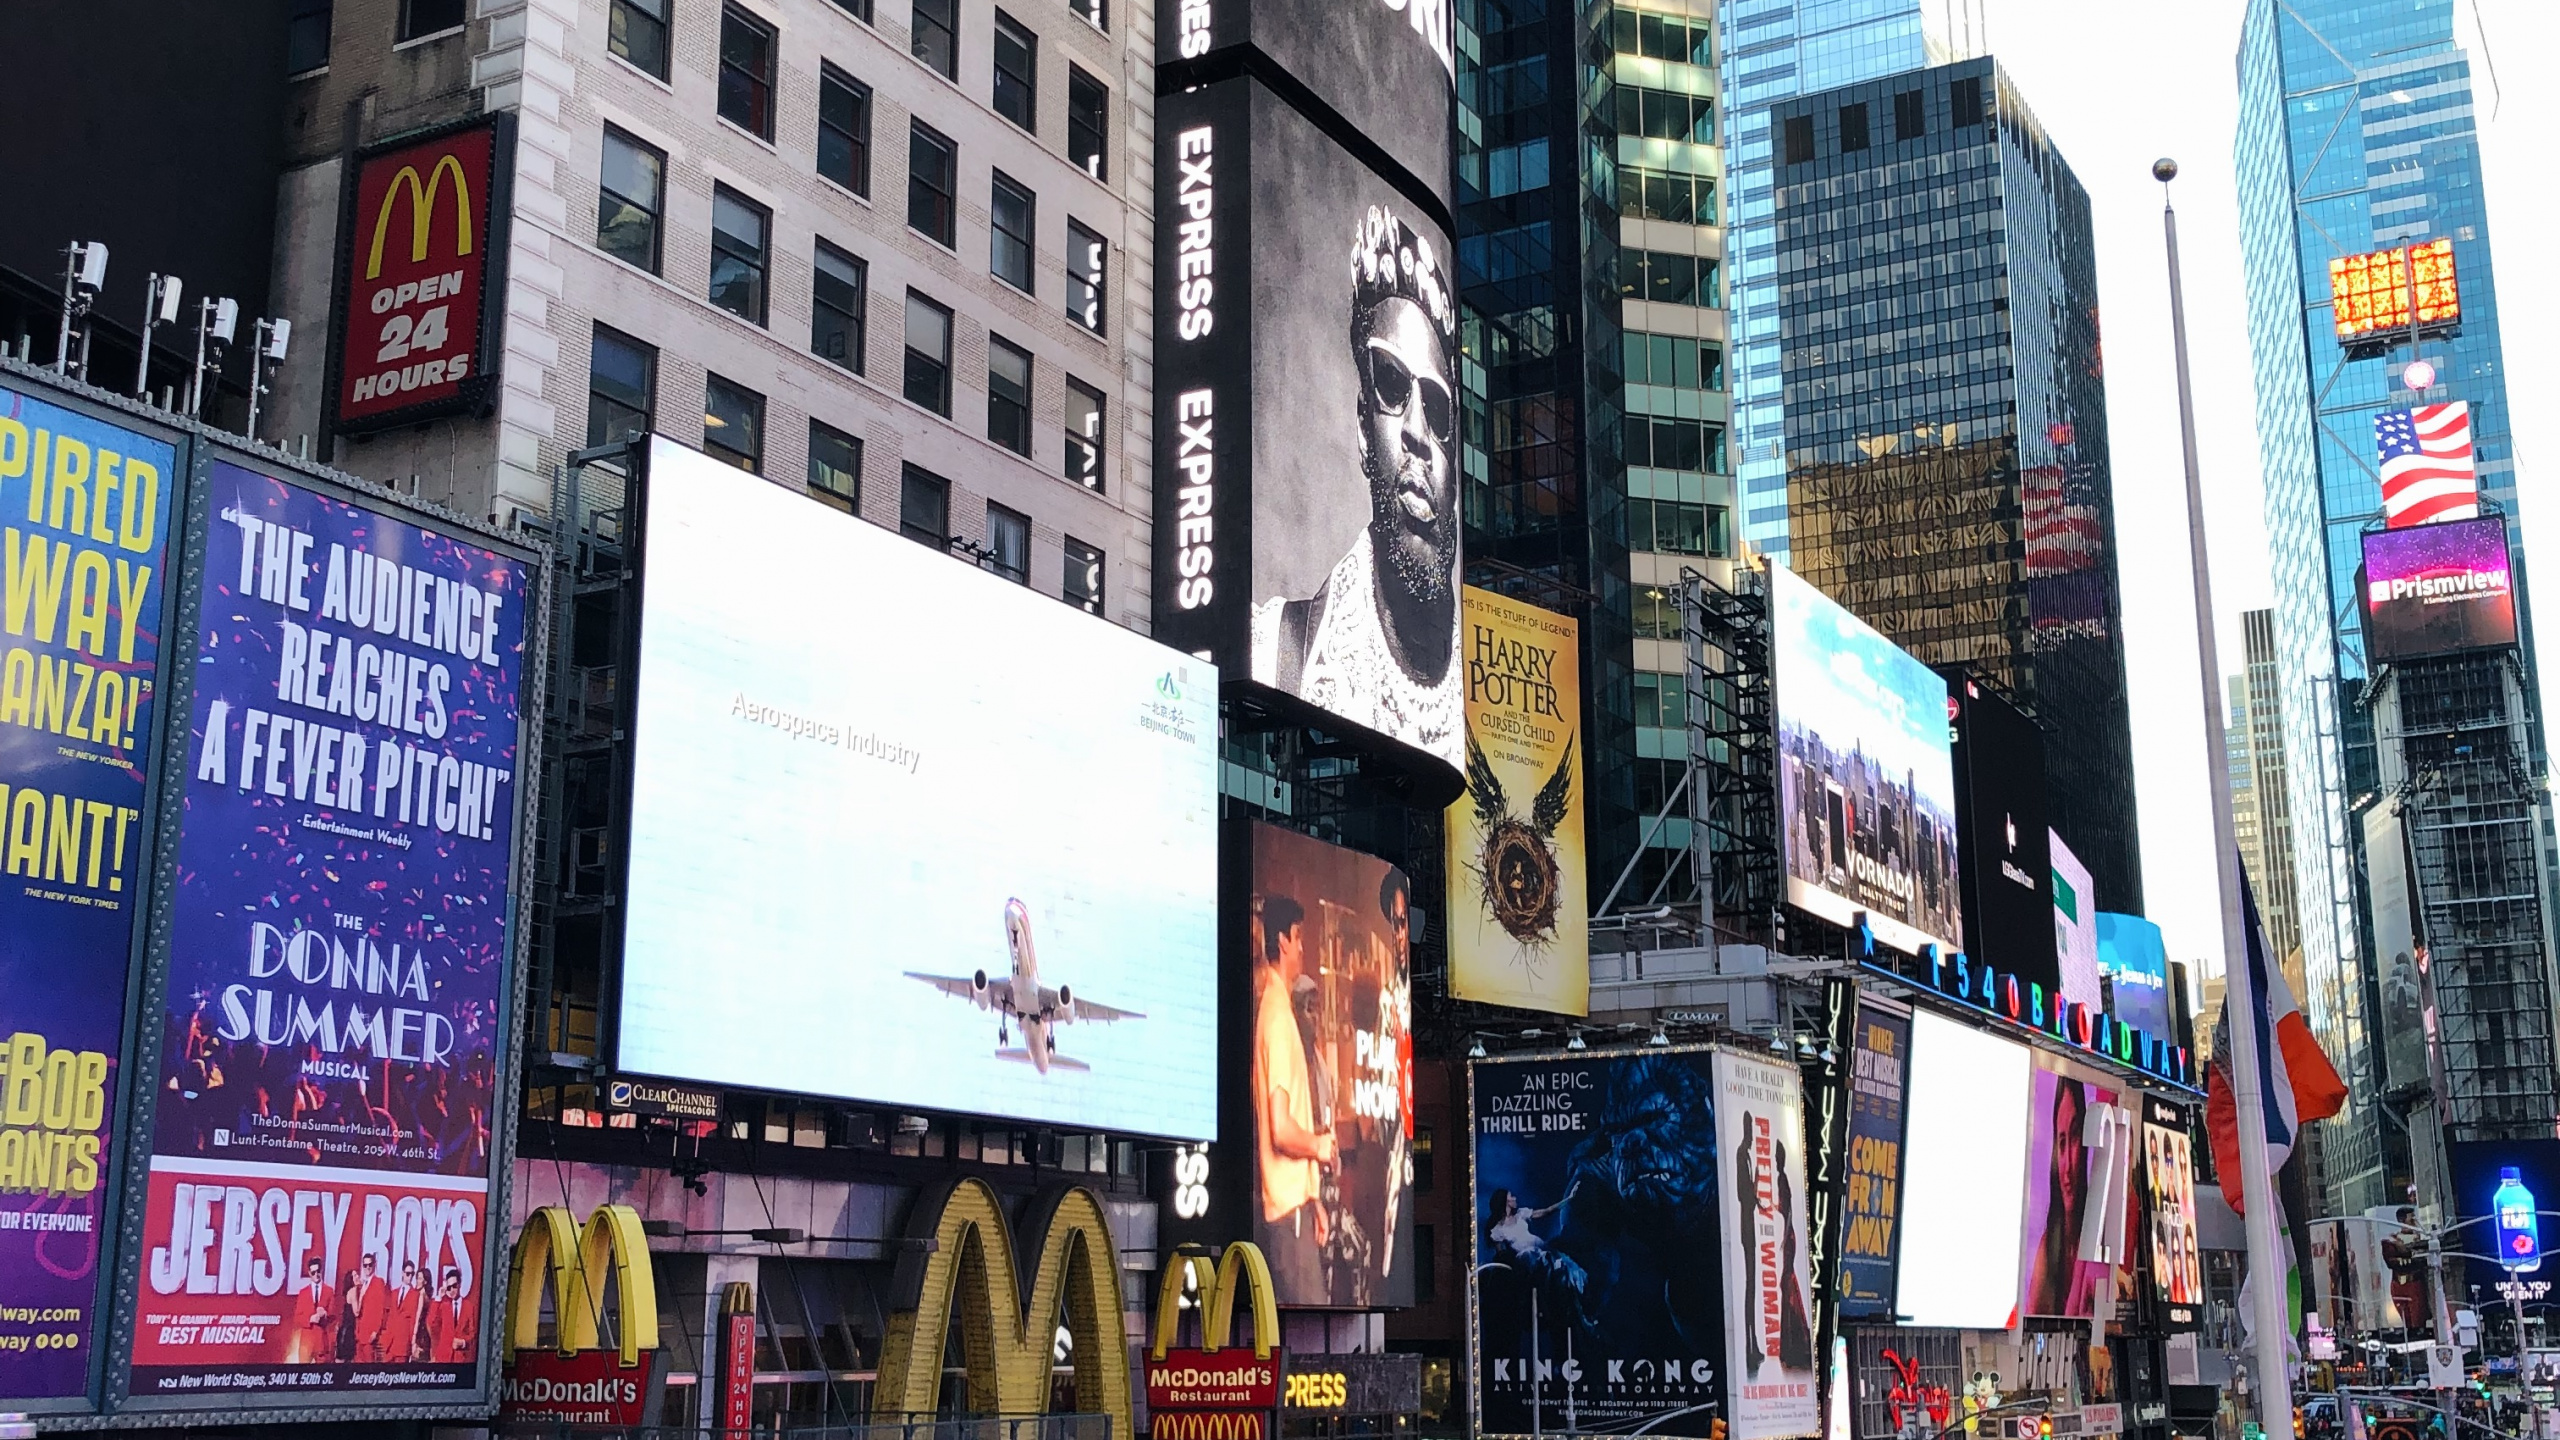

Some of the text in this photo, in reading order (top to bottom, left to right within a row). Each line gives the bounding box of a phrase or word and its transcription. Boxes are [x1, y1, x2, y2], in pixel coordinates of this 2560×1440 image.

[1179, 126, 1212, 342] EXPRESS
[371, 270, 463, 314] OPEN
[377, 305, 449, 363] 24
[352, 353, 469, 402] HOURS
[1179, 388, 1213, 610] EXPRESS
[5, 527, 152, 664] WAY
[220, 506, 502, 667] “THE AUDIENCE
[2392, 568, 2506, 600] Prismview
[2454, 591, 2482, 601] Electronics
[2483, 589, 2508, 600] Company
[1486, 604, 1501, 617] THE
[1503, 609, 1526, 625] STUFF
[1528, 618, 1538, 628] OF
[1474, 624, 1557, 684] HARRY
[278, 621, 450, 739] REACHES
[1469, 661, 1565, 722] POTTER
[1140, 715, 1196, 744] BEIJING TOWN
[1480, 712, 1555, 743] CURSED CHILD
[1504, 710, 1531, 723] AND THE
[732, 691, 920, 774] Aerospace Industry
[58, 747, 134, 769] THE NEW YORKER
[198, 699, 510, 841] A FEVER PITCH!”
[1493, 750, 1544, 769] ON BROADWAY
[377, 826, 412, 850] Weekly
[1845, 846, 1914, 902] VORNADO
[25, 887, 119, 910] THE NEW YORK TIMES
[1858, 884, 1905, 913] REALTY TRUST
[334, 912, 363, 930] THE
[250, 921, 430, 1001] DONNA
[217, 984, 455, 1067] SUMMER
[1673, 1011, 1720, 1021] LAMAR
[1926, 943, 2186, 1084] 1540 BROADWAY
[301, 1060, 370, 1081] MUSICAL
[1552, 1071, 1594, 1090] EPIC,
[1735, 1064, 1784, 1087] HAVE A REALLY
[1855, 1047, 1901, 1087] BEST MUSICAL
[1355, 1079, 1398, 1121] NOW
[1492, 1093, 1572, 1113] DAZZLING
[1725, 1080, 1795, 1107] GOOD TIME TONIGHT
[666, 1104, 716, 1116] SPECTACOLOR
[1481, 1115, 1536, 1133] THRILL
[252, 1114, 413, 1139] TheDonnaSummerMusical.com
[232, 1132, 313, 1150] Lunt-Fontanne
[317, 1139, 361, 1155] Theatre,
[364, 1145, 383, 1156] 205
[387, 1144, 399, 1156] W.
[401, 1147, 424, 1159] 46th
[1851, 1134, 1898, 1179] COME
[1754, 1116, 1774, 1223] PRETTY
[1848, 1173, 1896, 1218] FROM
[23, 1212, 93, 1232] EVERYONE
[1845, 1214, 1894, 1258] AWAY
[150, 1182, 476, 1299] JERSEY BOYS
[1761, 1241, 1781, 1358] WOMAN
[2528, 1281, 2551, 1292] YOU
[2535, 1290, 2545, 1300] IT
[159, 1326, 265, 1344] BEST MUSICAL
[737, 1322, 747, 1377] OPEN
[179, 1375, 202, 1388] New
[204, 1374, 231, 1387] World
[232, 1374, 266, 1388] Stages,
[268, 1373, 286, 1385] 340
[299, 1372, 320, 1385] 50th
[322, 1371, 334, 1385] St.
[349, 1371, 456, 1386] JerseyBoysNewYork.com
[1151, 1367, 1272, 1388] McDonald's
[1494, 1358, 1714, 1383] KING KONG
[733, 1383, 748, 1395] 24
[1170, 1390, 1251, 1402] Restaurant
[1607, 1385, 1714, 1394] BROADWAY
